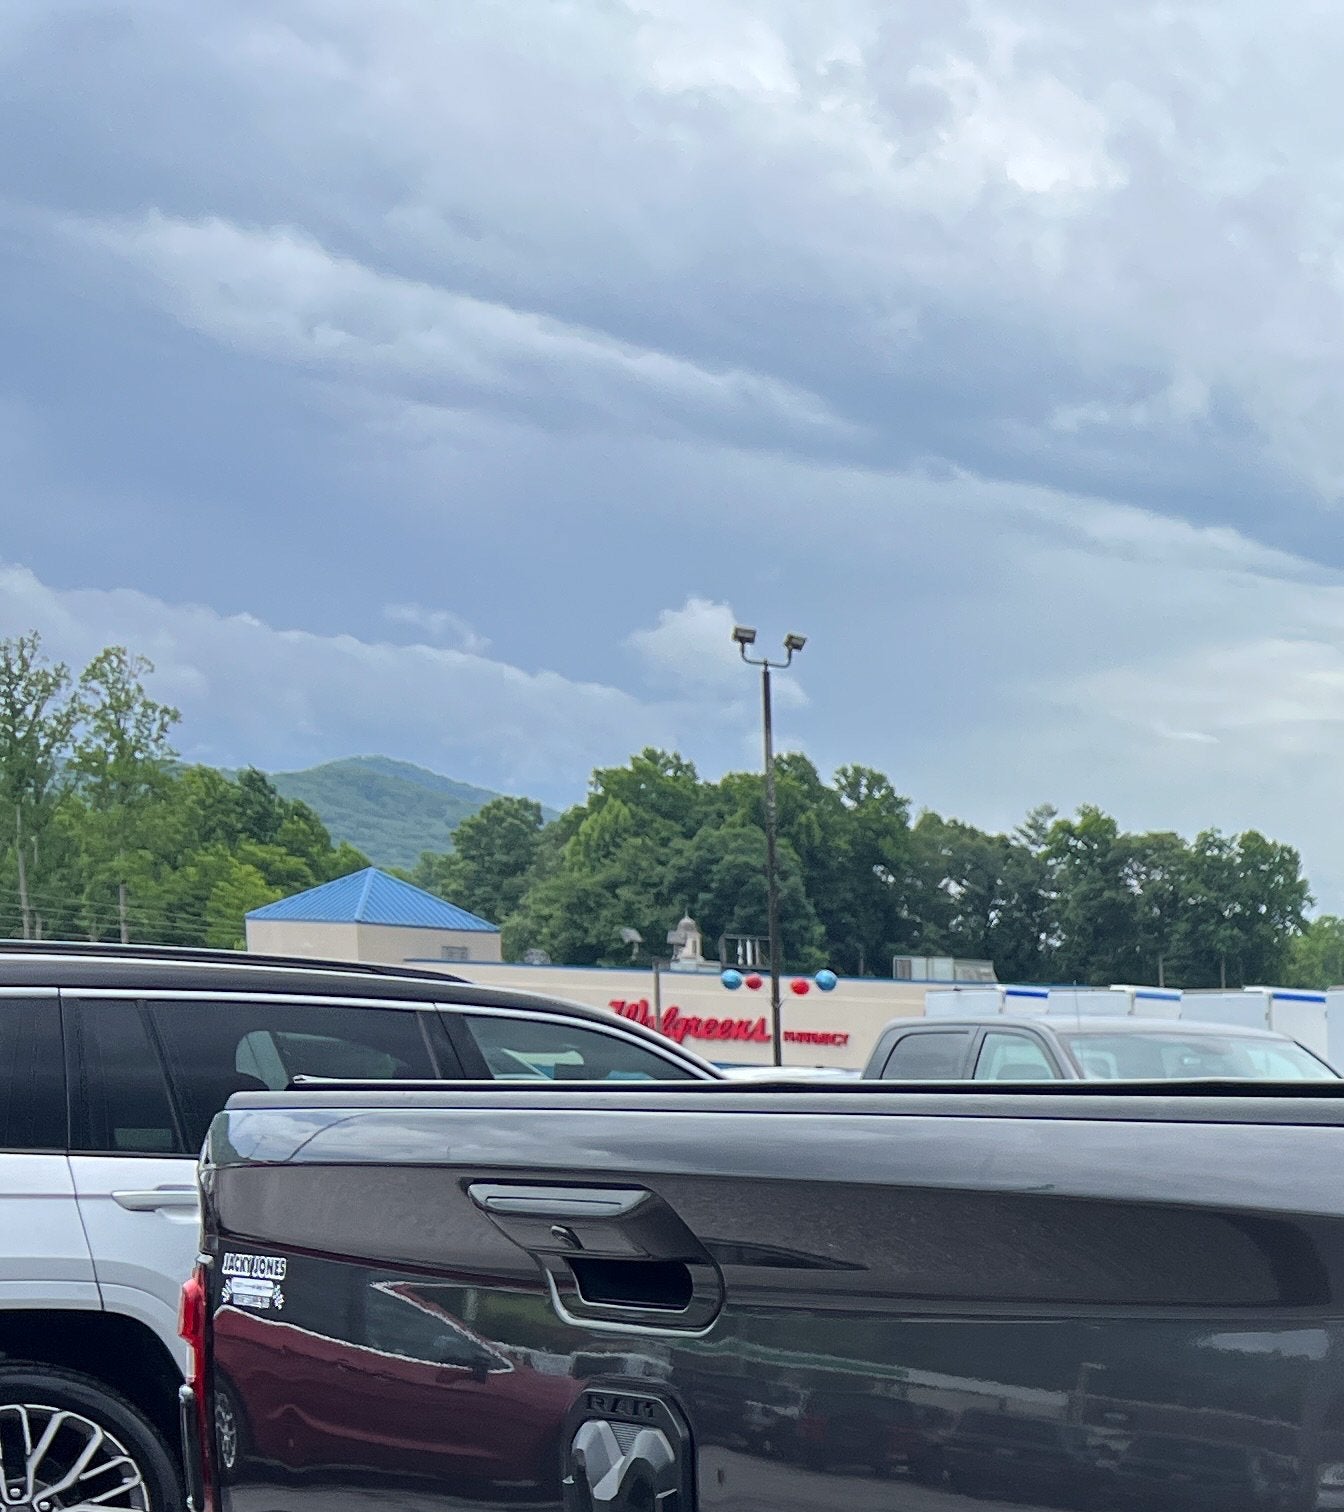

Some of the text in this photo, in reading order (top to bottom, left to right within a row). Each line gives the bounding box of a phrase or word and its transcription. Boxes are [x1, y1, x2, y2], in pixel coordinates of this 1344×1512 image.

[223, 1253, 286, 1279] JACKY JONES
[586, 1395, 656, 1417] RAM
